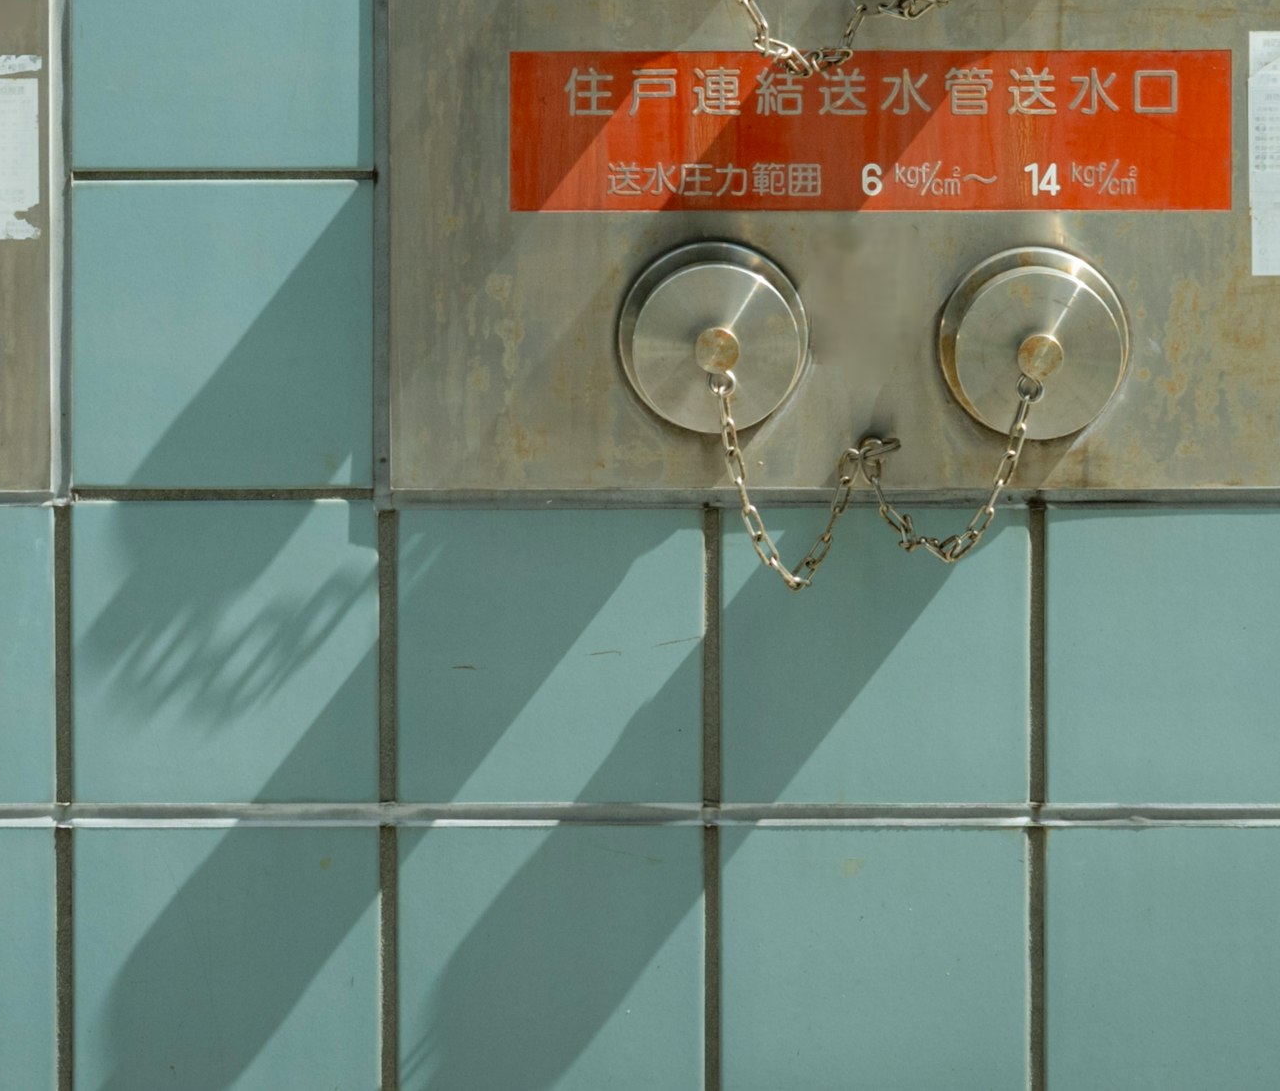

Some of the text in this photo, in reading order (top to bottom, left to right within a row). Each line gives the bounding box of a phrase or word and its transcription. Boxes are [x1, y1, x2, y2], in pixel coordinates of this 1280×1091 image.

[564, 67, 1178, 116] 住戸連結送水管送水口
[606, 162, 820, 196] 送水圧力範囲
[861, 164, 882, 196] 6
[1023, 163, 1061, 197] 14
